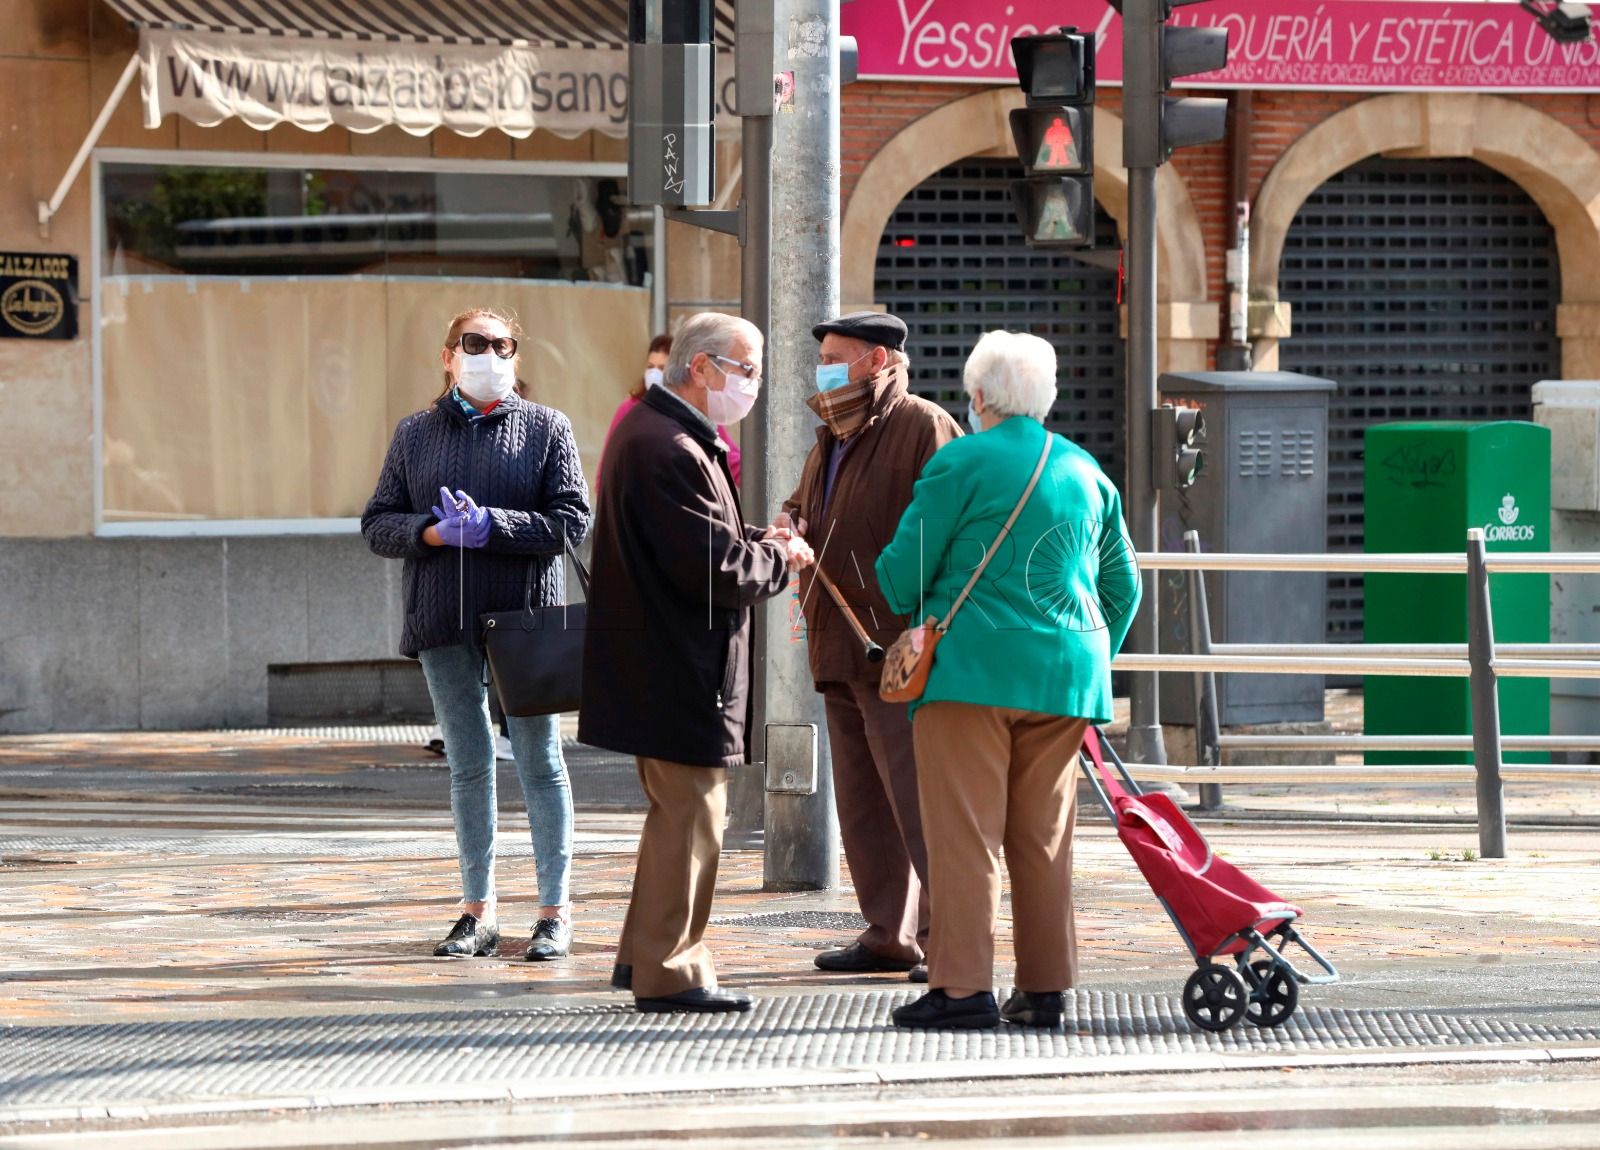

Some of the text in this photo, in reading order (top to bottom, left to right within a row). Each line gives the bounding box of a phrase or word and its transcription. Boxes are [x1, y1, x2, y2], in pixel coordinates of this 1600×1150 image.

[1349, 22, 1371, 62] Y
[1372, 7, 1514, 65] ESTÉTICA
[1484, 523, 1535, 542] CORREOS
